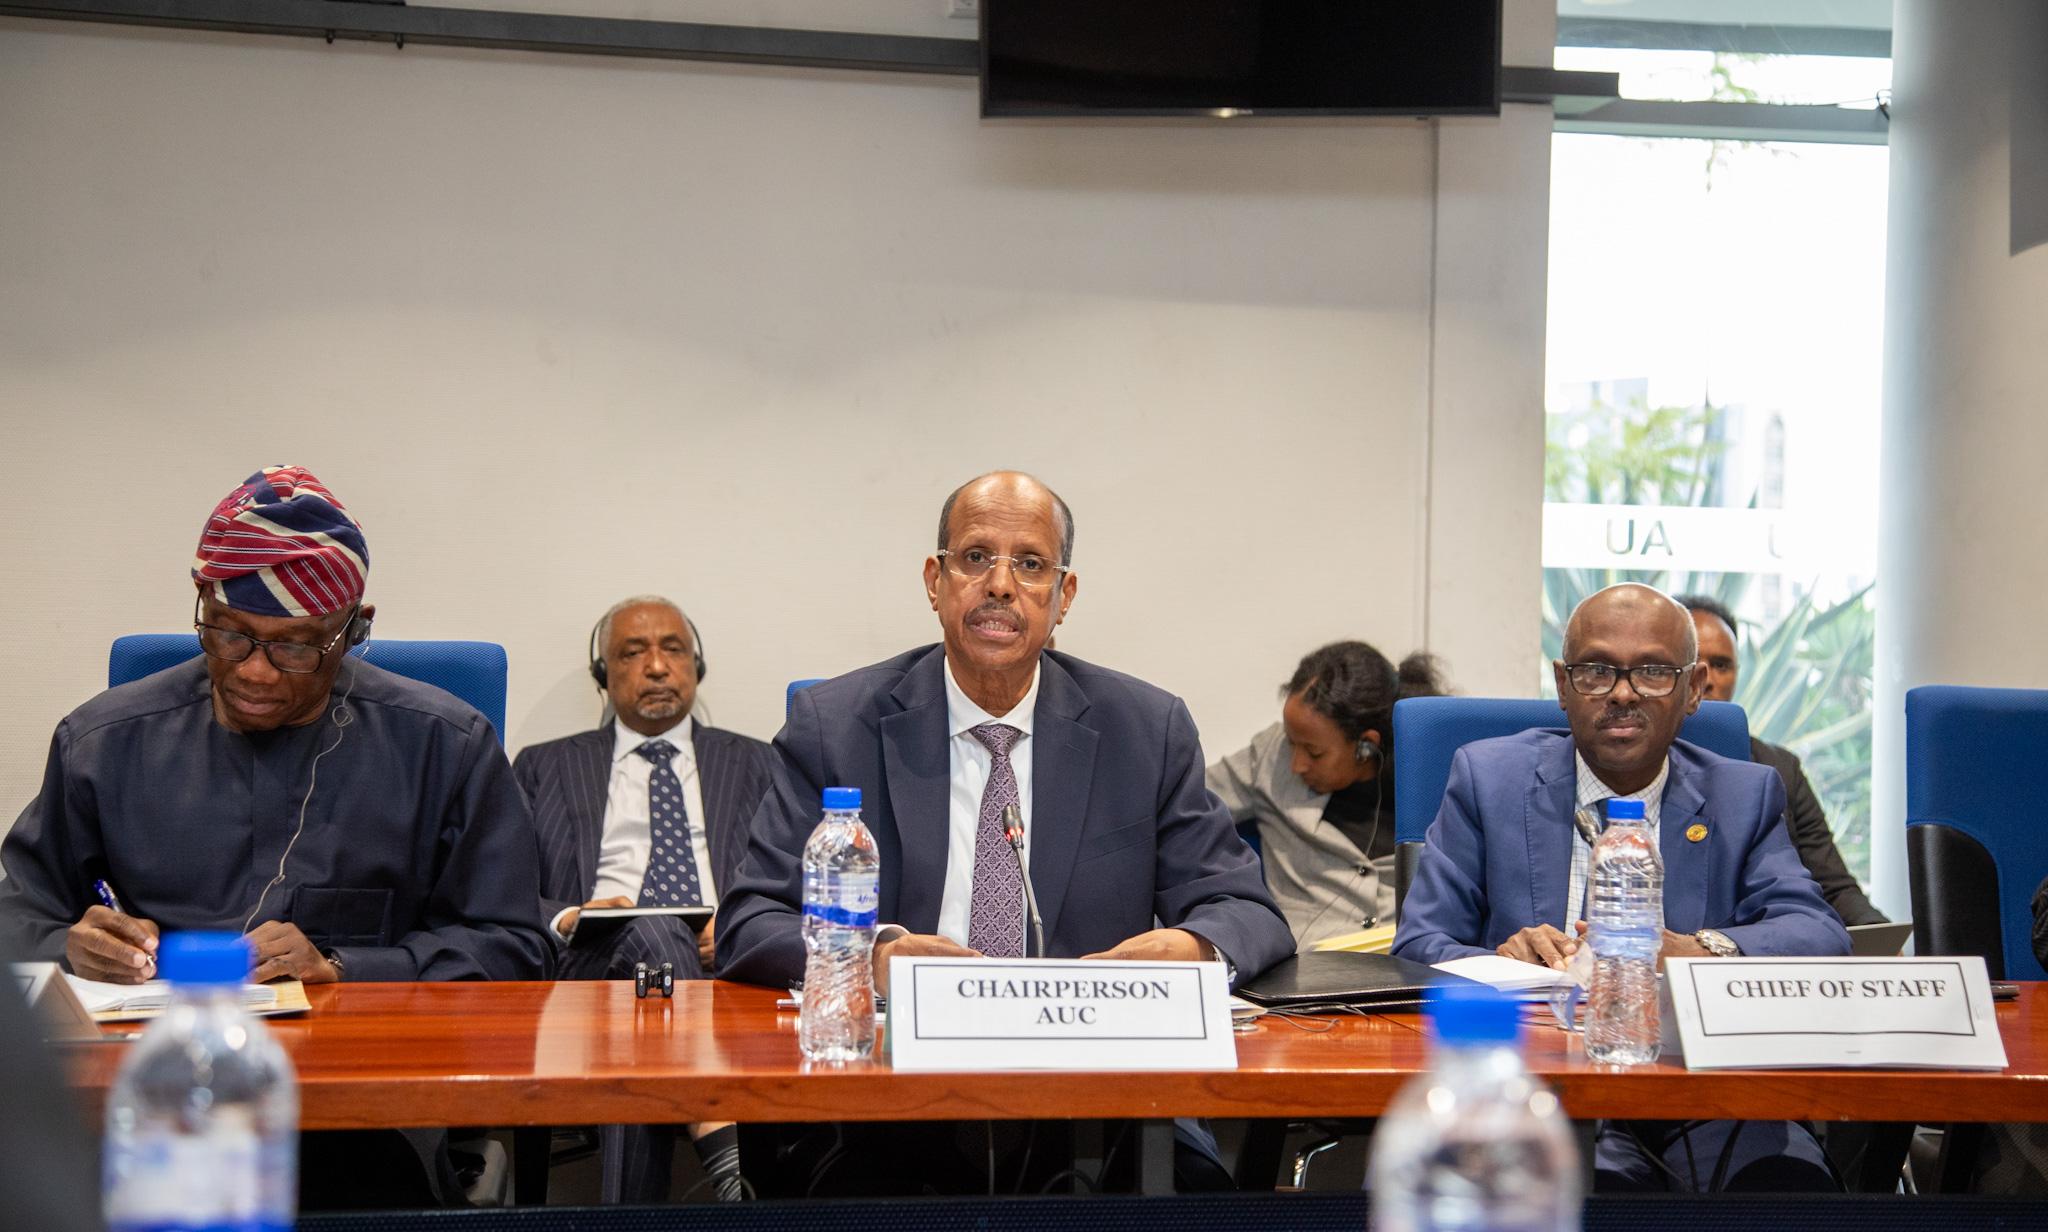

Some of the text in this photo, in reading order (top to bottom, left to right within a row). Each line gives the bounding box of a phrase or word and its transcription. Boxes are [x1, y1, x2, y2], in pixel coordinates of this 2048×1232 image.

[1606, 518, 1674, 556] UA
[957, 979, 1170, 999] CHAIRPERSON
[1727, 979, 1947, 998] CHIEF OF STAFF
[1036, 1006, 1097, 1024] AUC
